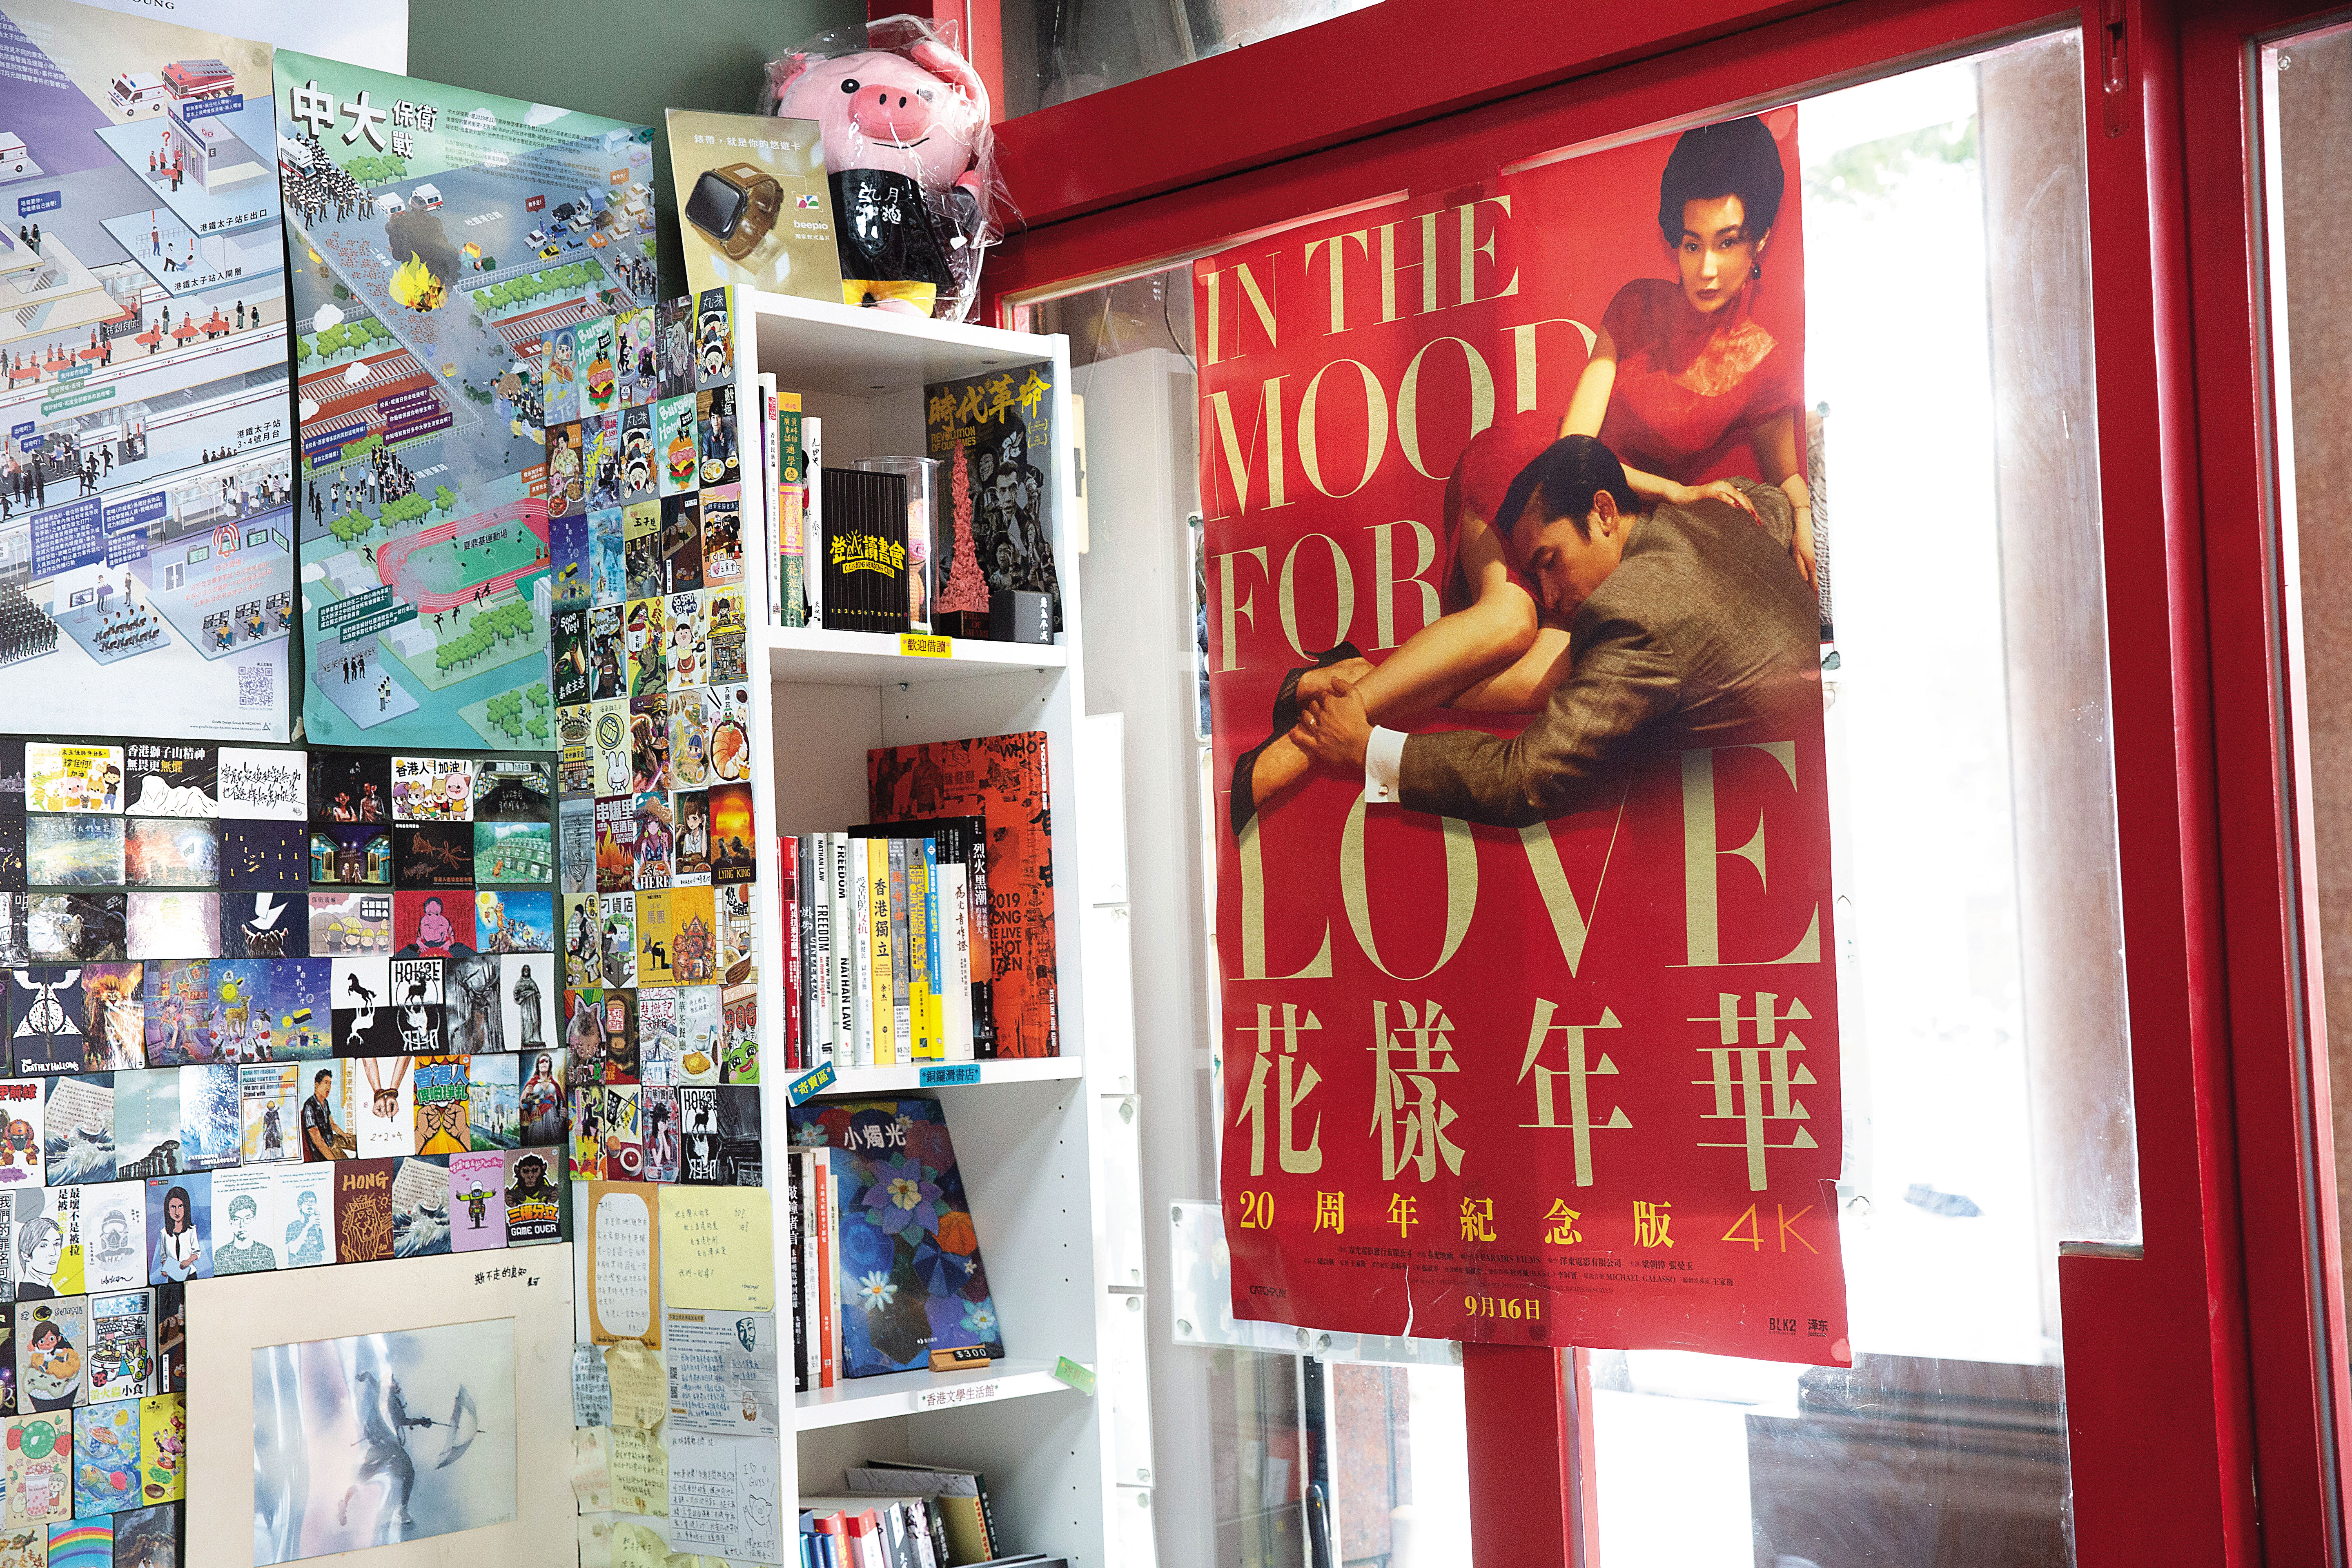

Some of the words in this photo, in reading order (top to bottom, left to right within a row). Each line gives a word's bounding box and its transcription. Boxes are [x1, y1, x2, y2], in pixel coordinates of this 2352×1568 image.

[694, 134, 801, 151] 錶帶，就是你的悠遊卡
[200, 209, 267, 232] 港鐵太子站E出口
[793, 220, 828, 230] beepio
[174, 268, 242, 291] 港鐵太子站入閘層
[1199, 251, 1282, 368] IN
[1305, 194, 1520, 336] THE
[928, 368, 1052, 431] 時代革命
[237, 419, 281, 439] 港鐵太子站
[1203, 318, 1598, 523] MOOD
[931, 426, 976, 444] REVOLUTION
[931, 443, 939, 452] OF
[956, 437, 976, 448] IMES
[1210, 519, 1442, 674] FOR
[127, 745, 205, 761] 香港獅子山精神
[126, 758, 183, 773] 無畏更無懼
[837, 845, 847, 899] FREEDOM
[1221, 740, 1822, 981] LOVE
[639, 875, 670, 889] HERE
[718, 868, 734, 880] LYING
[736, 866, 751, 878] KING
[972, 842, 987, 904] 烈火黑潮
[916, 868, 926, 936] REVOLUTION
[991, 893, 1020, 908] 2019
[818, 905, 829, 951] FREEDOM
[874, 878, 890, 958] 香港獨立
[1000, 927, 1021, 940] LIVE
[840, 958, 850, 996] NATHAN
[841, 998, 851, 1031] LAW
[414, 1064, 469, 1089] 香港人
[1235, 991, 1820, 1193] 花樣年華
[843, 1123, 906, 1151] 小燭光
[343, 1171, 389, 1191] HONG
[69, 1187, 80, 1256] 最壞不是被拉
[788, 1185, 798, 1245] 敲鐘者言
[511, 1226, 535, 1236] GAME
[537, 1224, 557, 1234] OVER
[1721, 1203, 1819, 1254] 4K
[1480, 1253, 1513, 1263] PARADIS
[1515, 1255, 1541, 1264] FILMS
[1642, 1259, 1666, 1270] 梁朝偉
[1669, 1260, 1694, 1271] 張曼玉
[1606, 1273, 1640, 1282] MICHAEL
[1642, 1275, 1677, 1284] GALASSO
[1464, 1295, 1541, 1320] 9月16日
[1770, 1318, 1796, 1332] BLK2
[956, 1348, 987, 1359] $300
